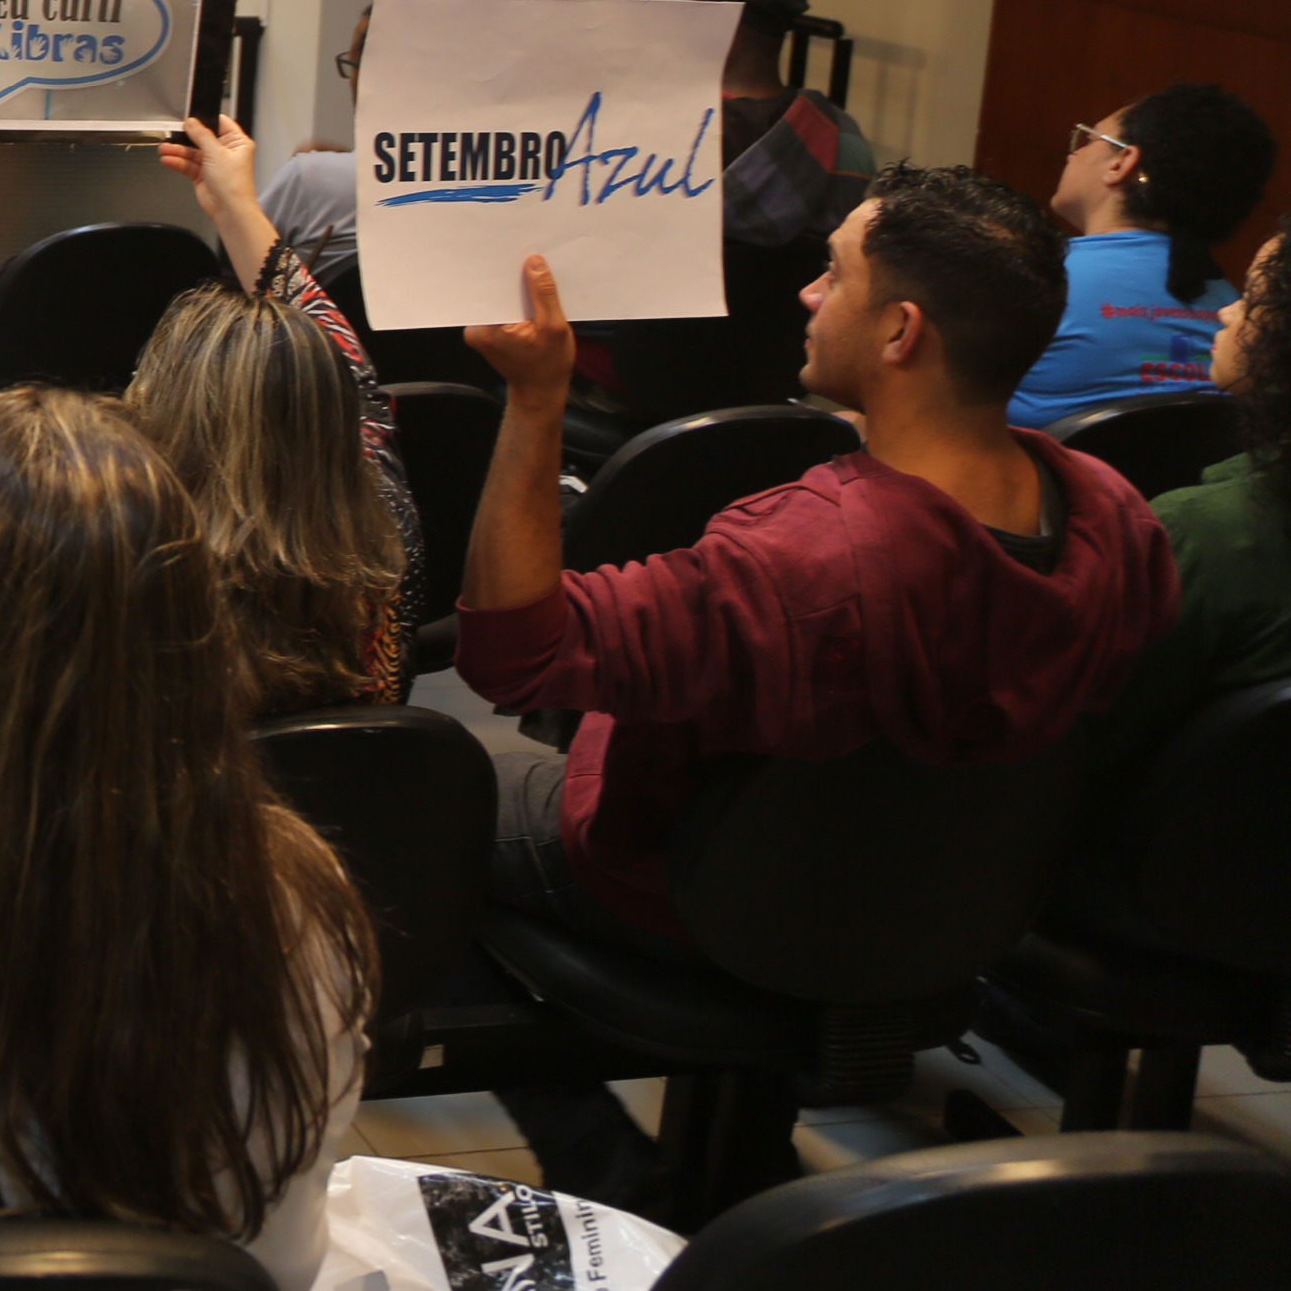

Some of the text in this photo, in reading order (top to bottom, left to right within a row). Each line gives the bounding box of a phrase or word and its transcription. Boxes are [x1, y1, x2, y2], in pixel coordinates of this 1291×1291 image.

[374, 90, 715, 206] SETEMBRO Azul
[515, 1184, 549, 1248] STILO
[575, 1199, 607, 1283] Feminin
